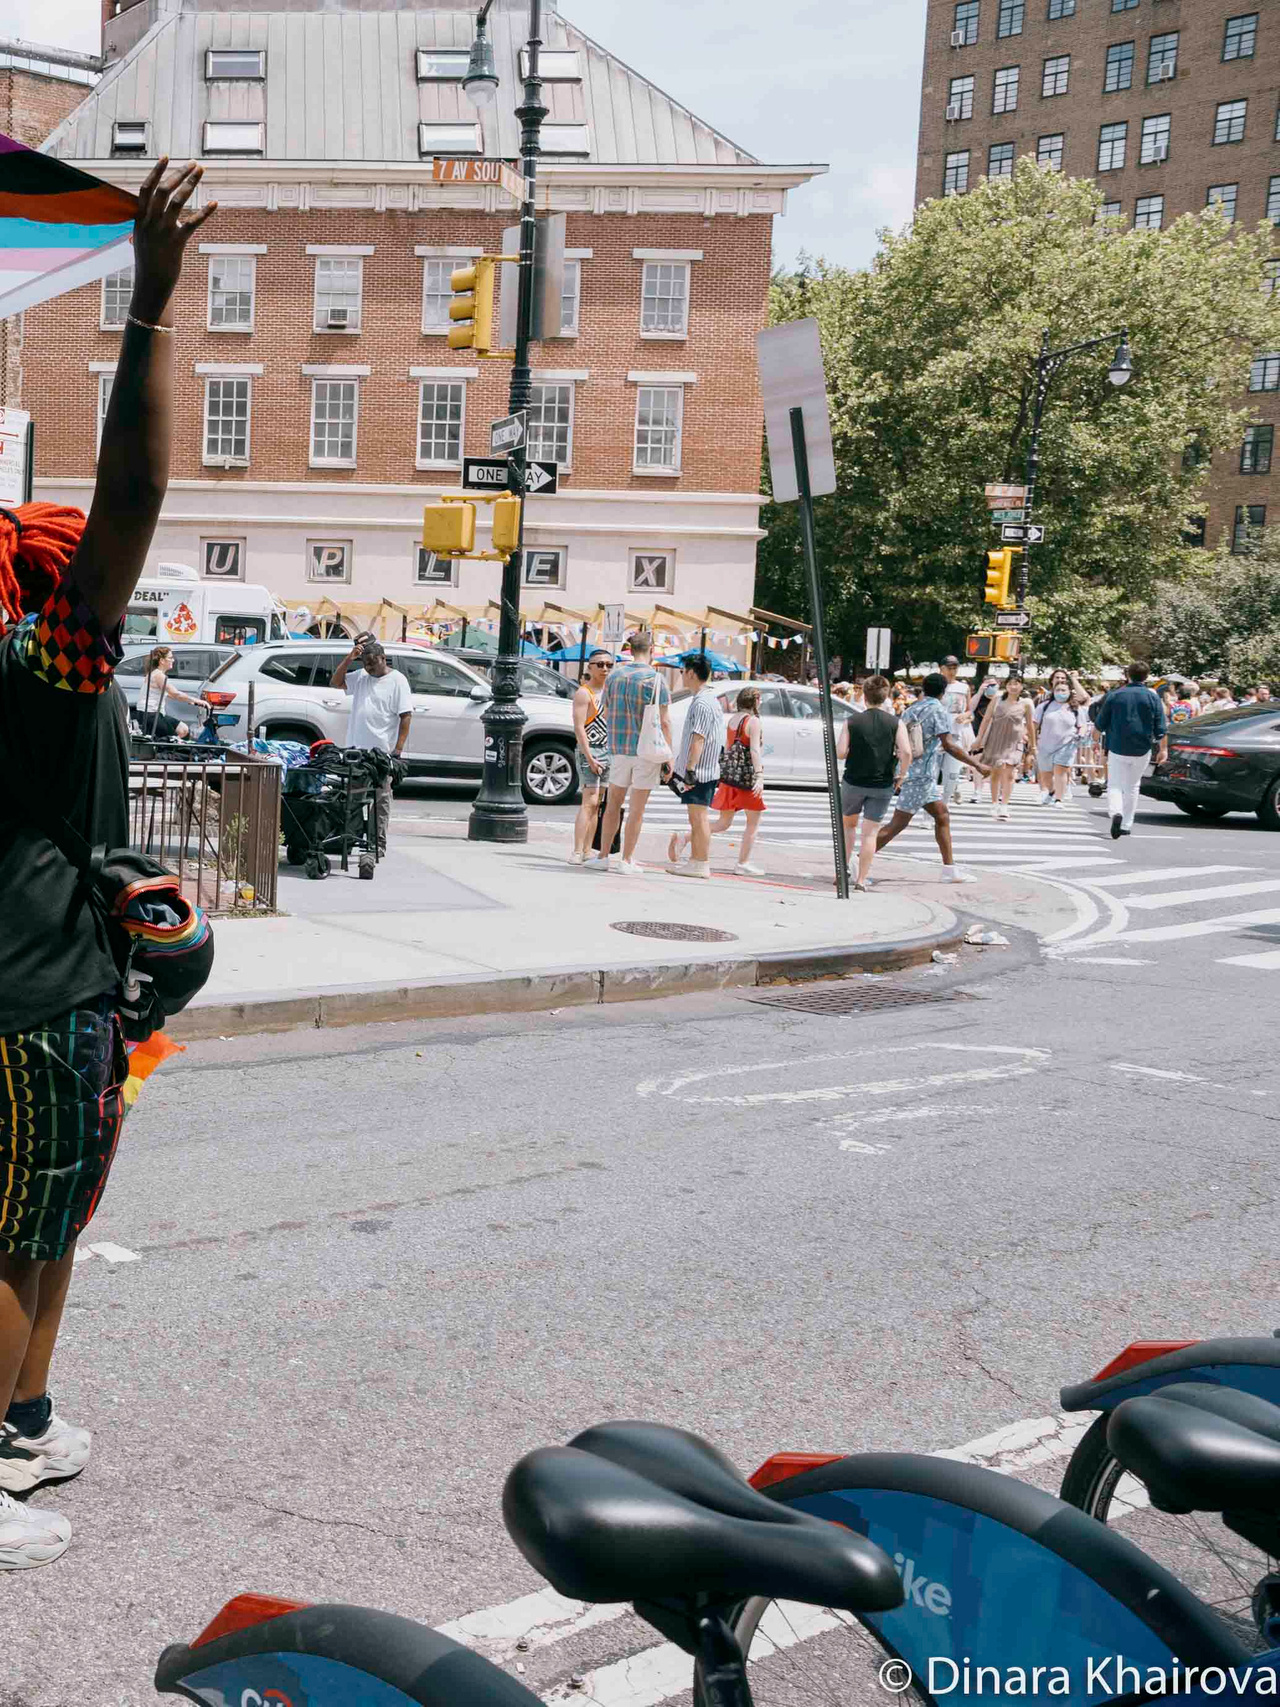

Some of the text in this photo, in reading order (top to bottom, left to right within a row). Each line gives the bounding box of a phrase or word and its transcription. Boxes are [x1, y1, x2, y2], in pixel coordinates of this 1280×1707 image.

[439, 161, 448, 181] 7
[451, 161, 469, 181] AV
[477, 468, 544, 484] ONE AY
